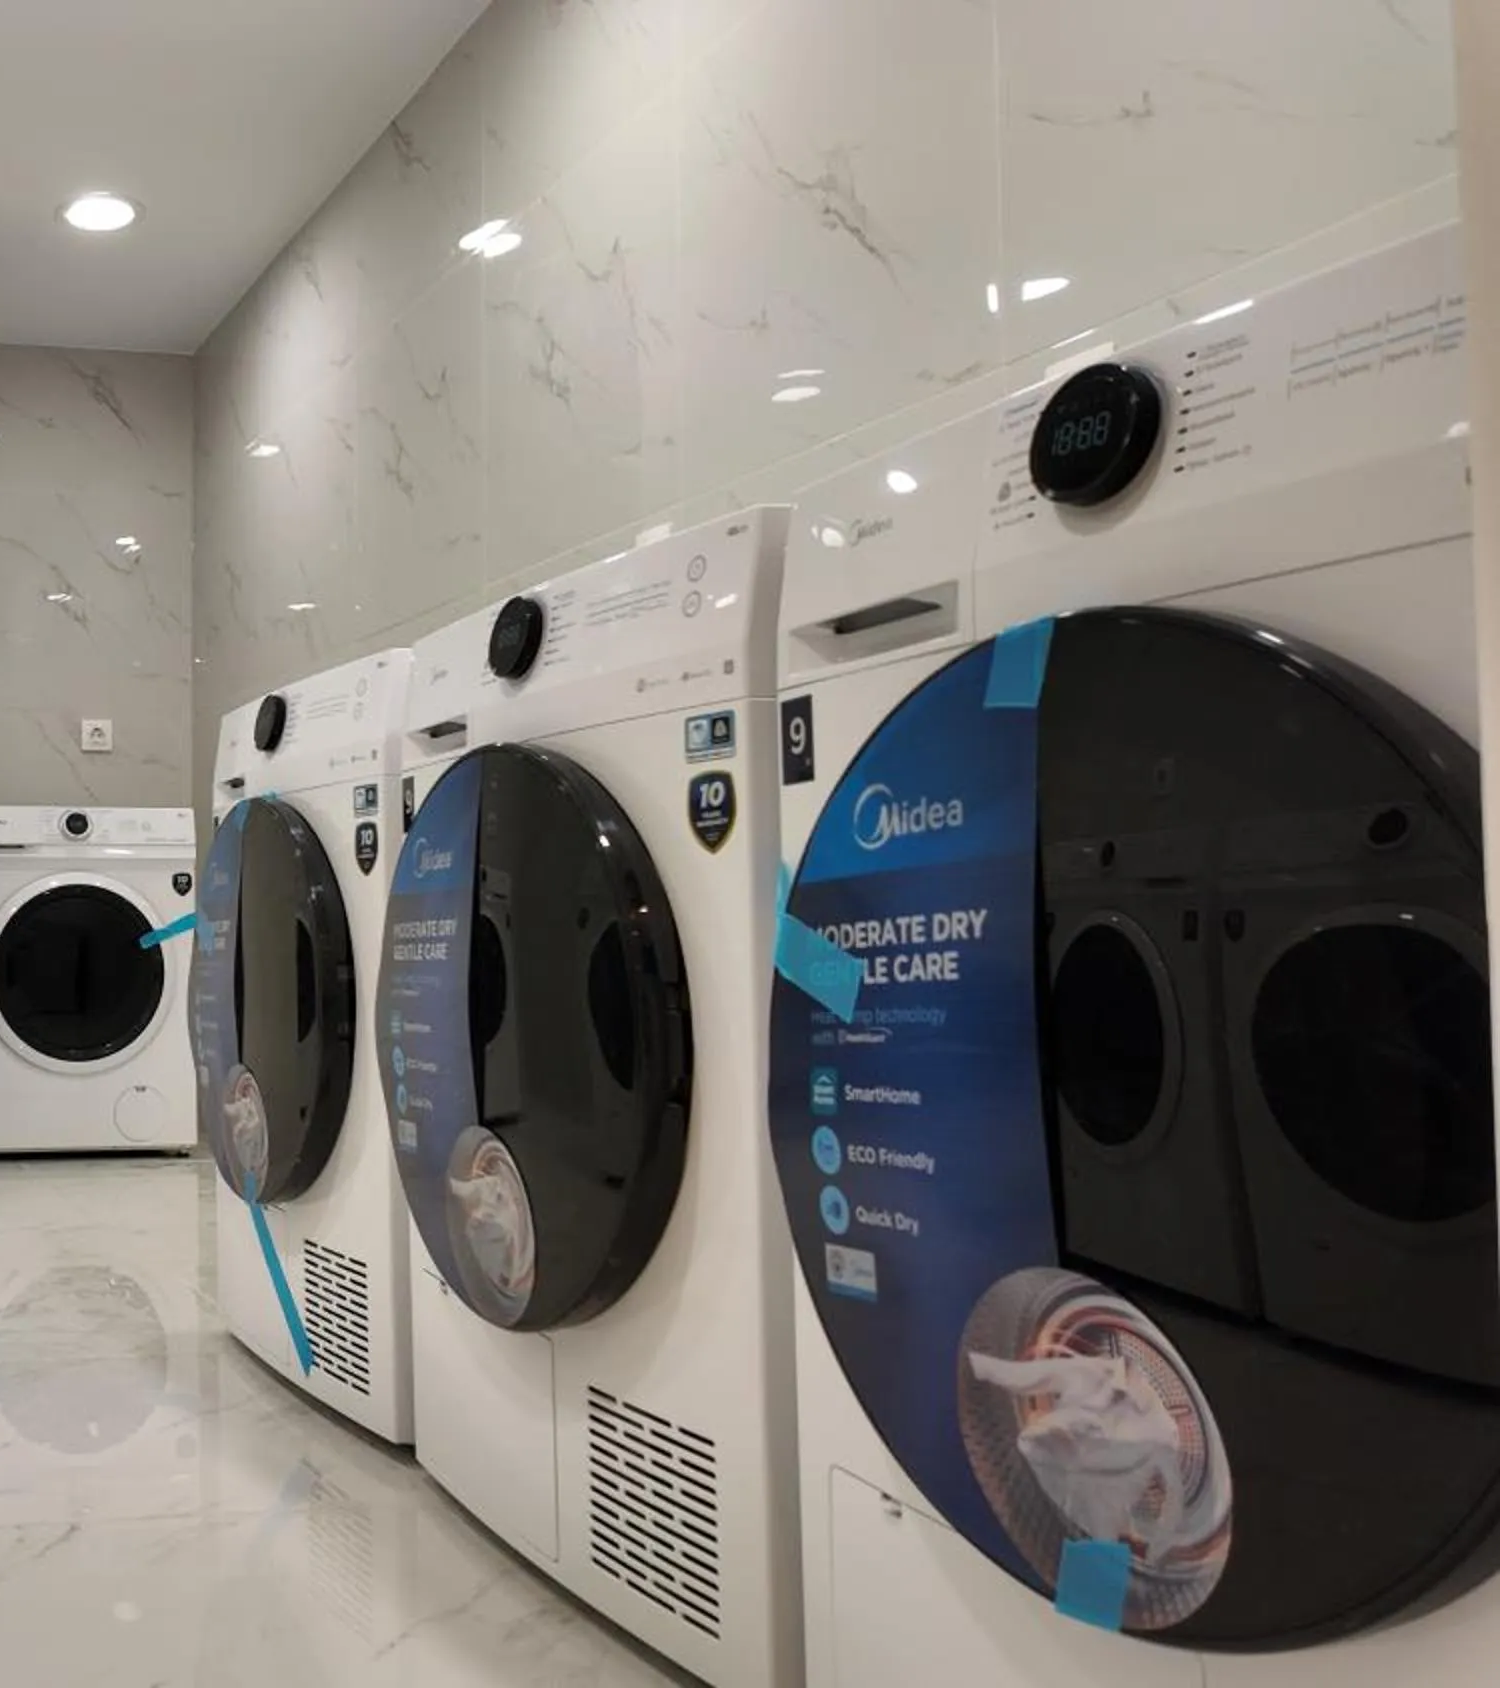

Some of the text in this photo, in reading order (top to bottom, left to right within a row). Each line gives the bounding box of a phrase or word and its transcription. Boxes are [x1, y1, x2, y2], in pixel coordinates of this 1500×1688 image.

[790, 716, 806, 755] 9
[405, 789, 413, 814] 9
[700, 781, 725, 808] 10
[854, 783, 963, 850] Midea
[360, 829, 374, 847] 10
[932, 908, 988, 941] DRY
[894, 951, 959, 983] CARE
[845, 1084, 921, 1105] SmartHome
[847, 1145, 935, 1174] ECO Friendly
[856, 1206, 919, 1236] Quick Dry
